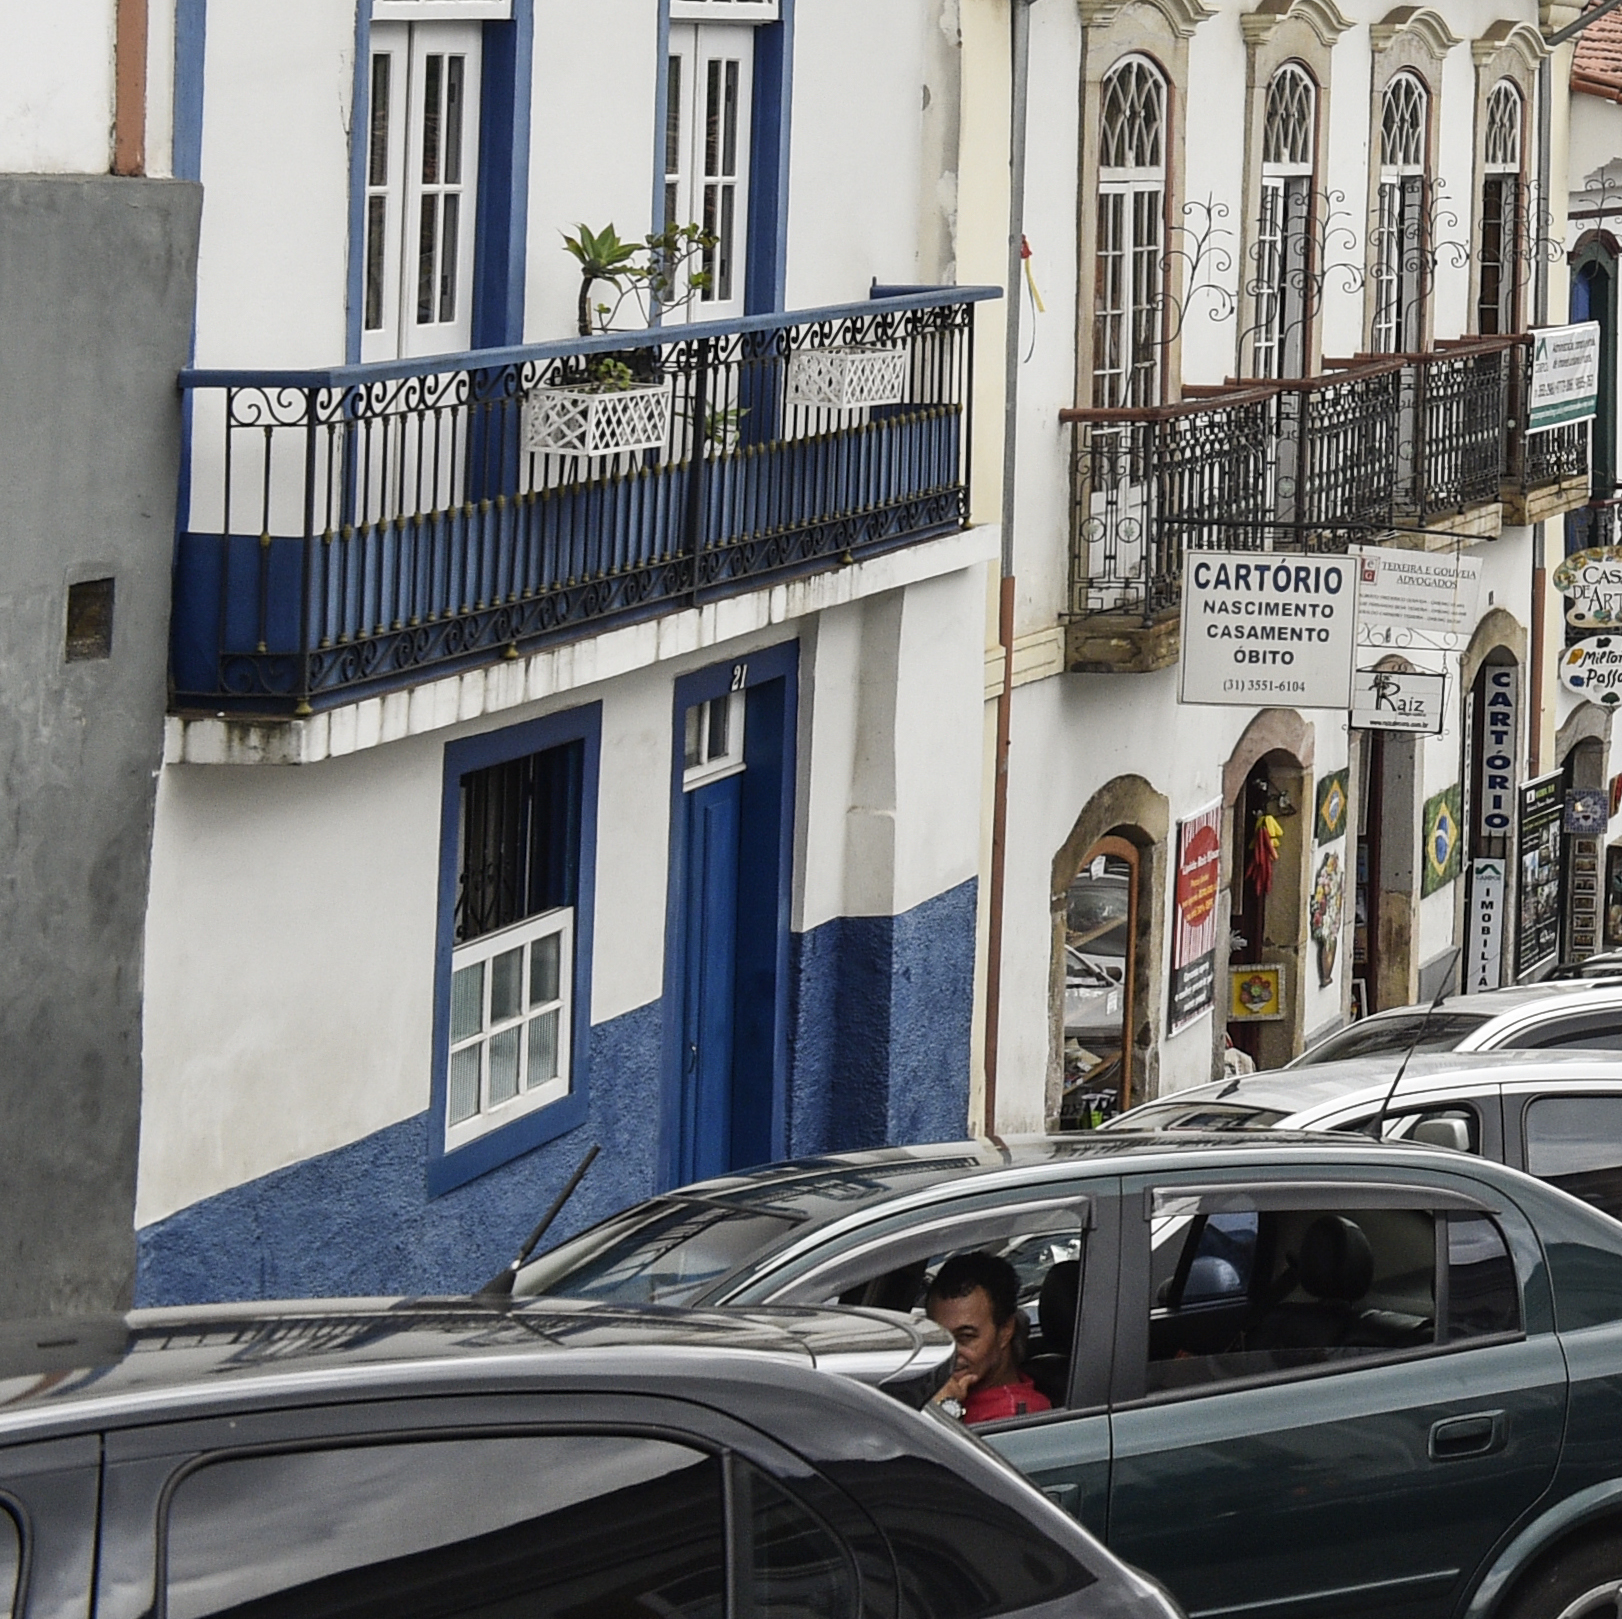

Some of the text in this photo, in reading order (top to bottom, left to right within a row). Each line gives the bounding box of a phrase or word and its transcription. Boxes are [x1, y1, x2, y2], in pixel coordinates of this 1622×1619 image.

[1194, 558, 1343, 595] CARTÓRIO
[1382, 561, 1477, 580] TEIXEIRA E GOUVEIA
[1396, 575, 1458, 589] ADVOGADOS
[1573, 585, 1591, 599] DE
[1203, 599, 1334, 619] NASCIMENTO
[1206, 624, 1330, 643] CASAMENTO
[1233, 646, 1295, 665] ÓBITO
[731, 664, 748, 692] 21
[1223, 679, 1306, 692] (31) 3551-6104
[1368, 680, 1424, 713] Raiz
[1484, 671, 1513, 828] CARTÓRIO
